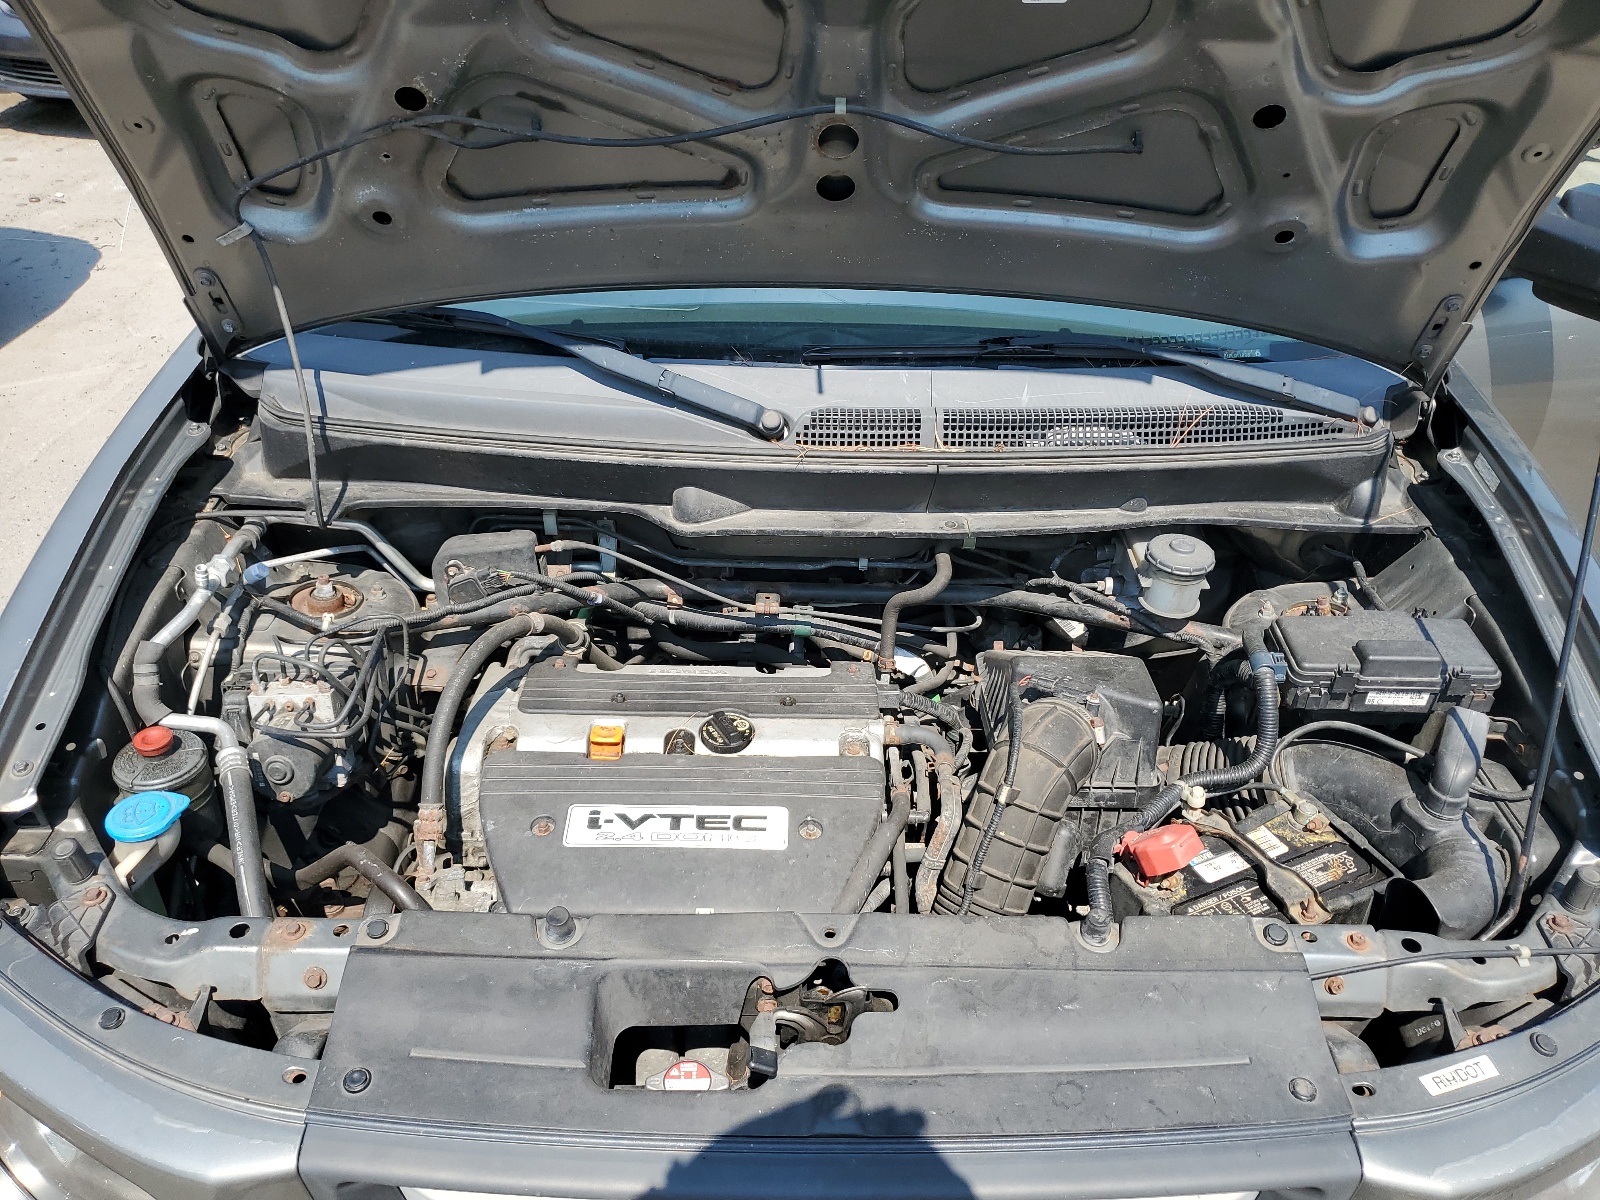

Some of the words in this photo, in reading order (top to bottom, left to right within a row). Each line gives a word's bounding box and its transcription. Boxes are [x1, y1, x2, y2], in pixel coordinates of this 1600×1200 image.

[587, 810, 768, 832] i-VTEC
[595, 832, 644, 841] 2.4
[1193, 897, 1219, 910] DANGER
[1222, 885, 1246, 899] POISON
